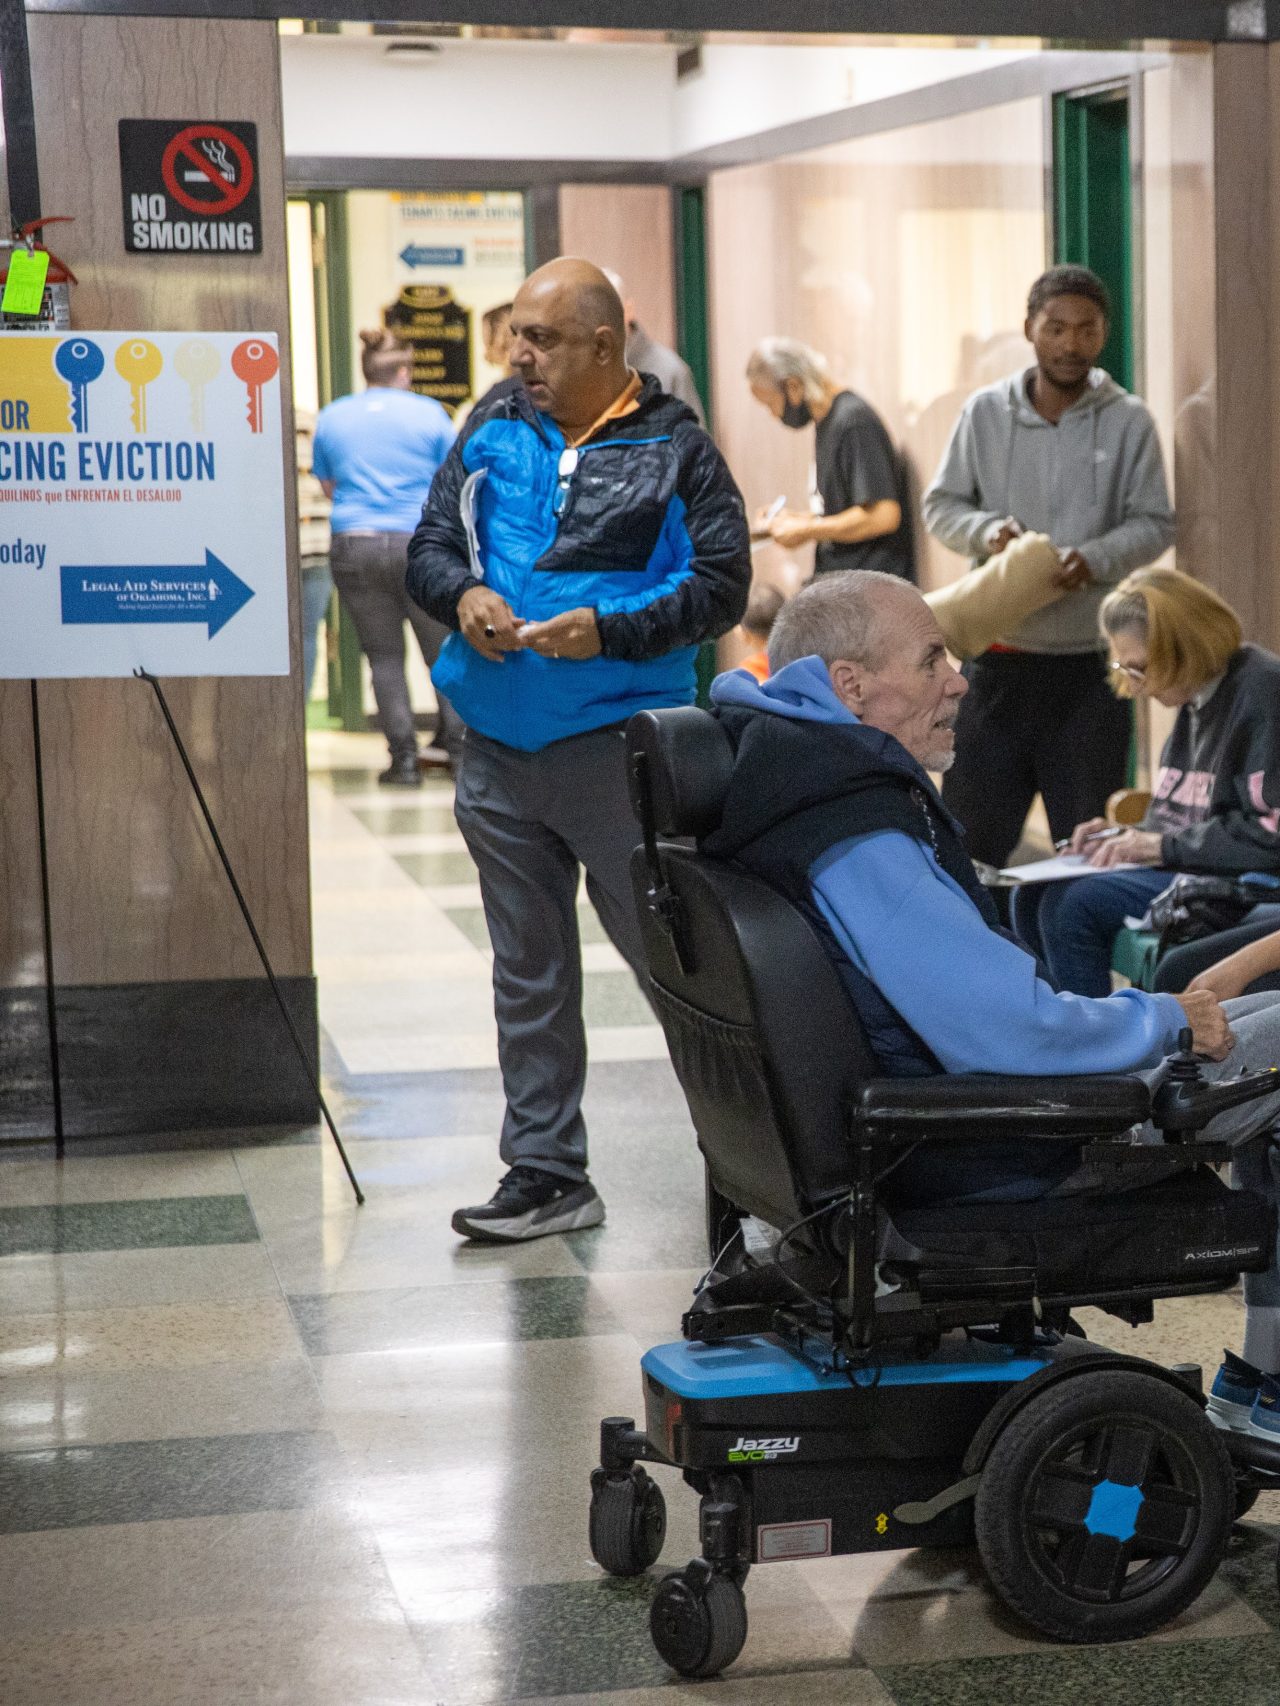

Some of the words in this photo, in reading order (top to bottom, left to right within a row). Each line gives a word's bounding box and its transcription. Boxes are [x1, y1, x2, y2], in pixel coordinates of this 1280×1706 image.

[131, 193, 166, 221] NO
[133, 221, 254, 250] SMOKING
[78, 441, 215, 481] EVICTION
[45, 492, 62, 505] que
[65, 489, 120, 502] ENFRENTAN
[123, 489, 133, 502] EL
[136, 489, 182, 502] DESALOJO
[728, 1437, 800, 1453] Jazzy
